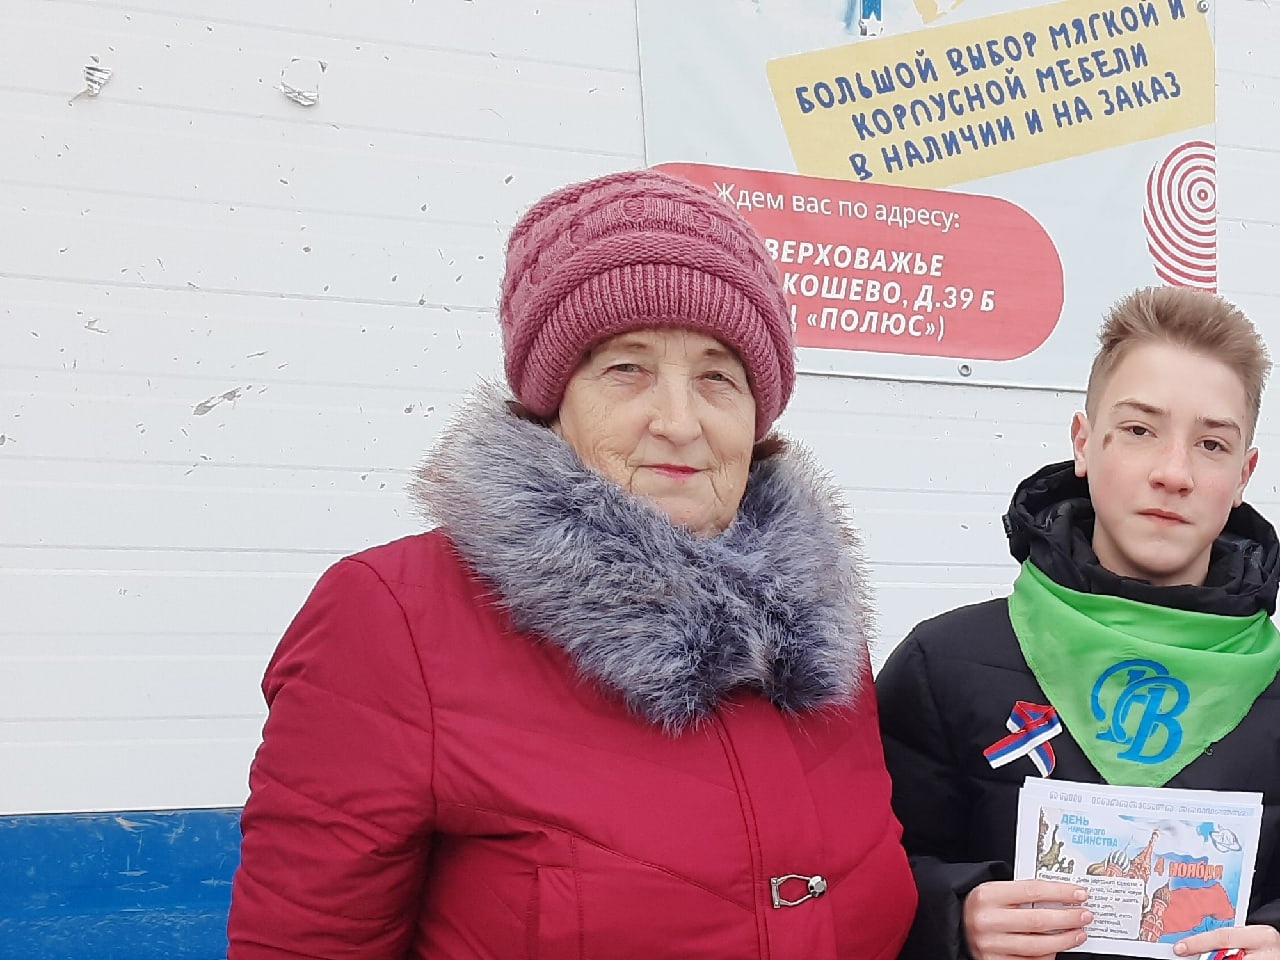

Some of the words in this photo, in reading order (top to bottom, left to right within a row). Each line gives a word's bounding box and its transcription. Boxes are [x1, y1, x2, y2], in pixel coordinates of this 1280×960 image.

[795, 49, 939, 114] БОЛЬШОЙ
[945, 31, 1037, 77] ВЫБОР
[1048, 0, 1160, 51] МЯГКОЙ
[1167, 0, 1186, 21] И
[851, 66, 1027, 141] КОРПУСНОЙ
[1035, 42, 1149, 93] МЕБЕЛИ
[848, 153, 873, 181] В
[880, 115, 1016, 173] НАЛИЧИИ
[1024, 108, 1044, 135] И
[1052, 96, 1093, 128] НА
[1097, 71, 1181, 116] ЗАКАЗ
[713, 181, 784, 212] Ждем
[792, 195, 832, 215] вас
[838, 200, 868, 219] по
[875, 203, 960, 233] адресу:
[764, 238, 945, 277] ВЕРХОВАЖЬЕ
[782, 272, 909, 308] КОШЕВО,
[807, 307, 945, 342] «ПОЛЮС»)
[1061, 813, 1090, 826] ДЕНЬ
[1071, 834, 1118, 847] ЕДИНСТВА
[1153, 856, 1165, 877] 4
